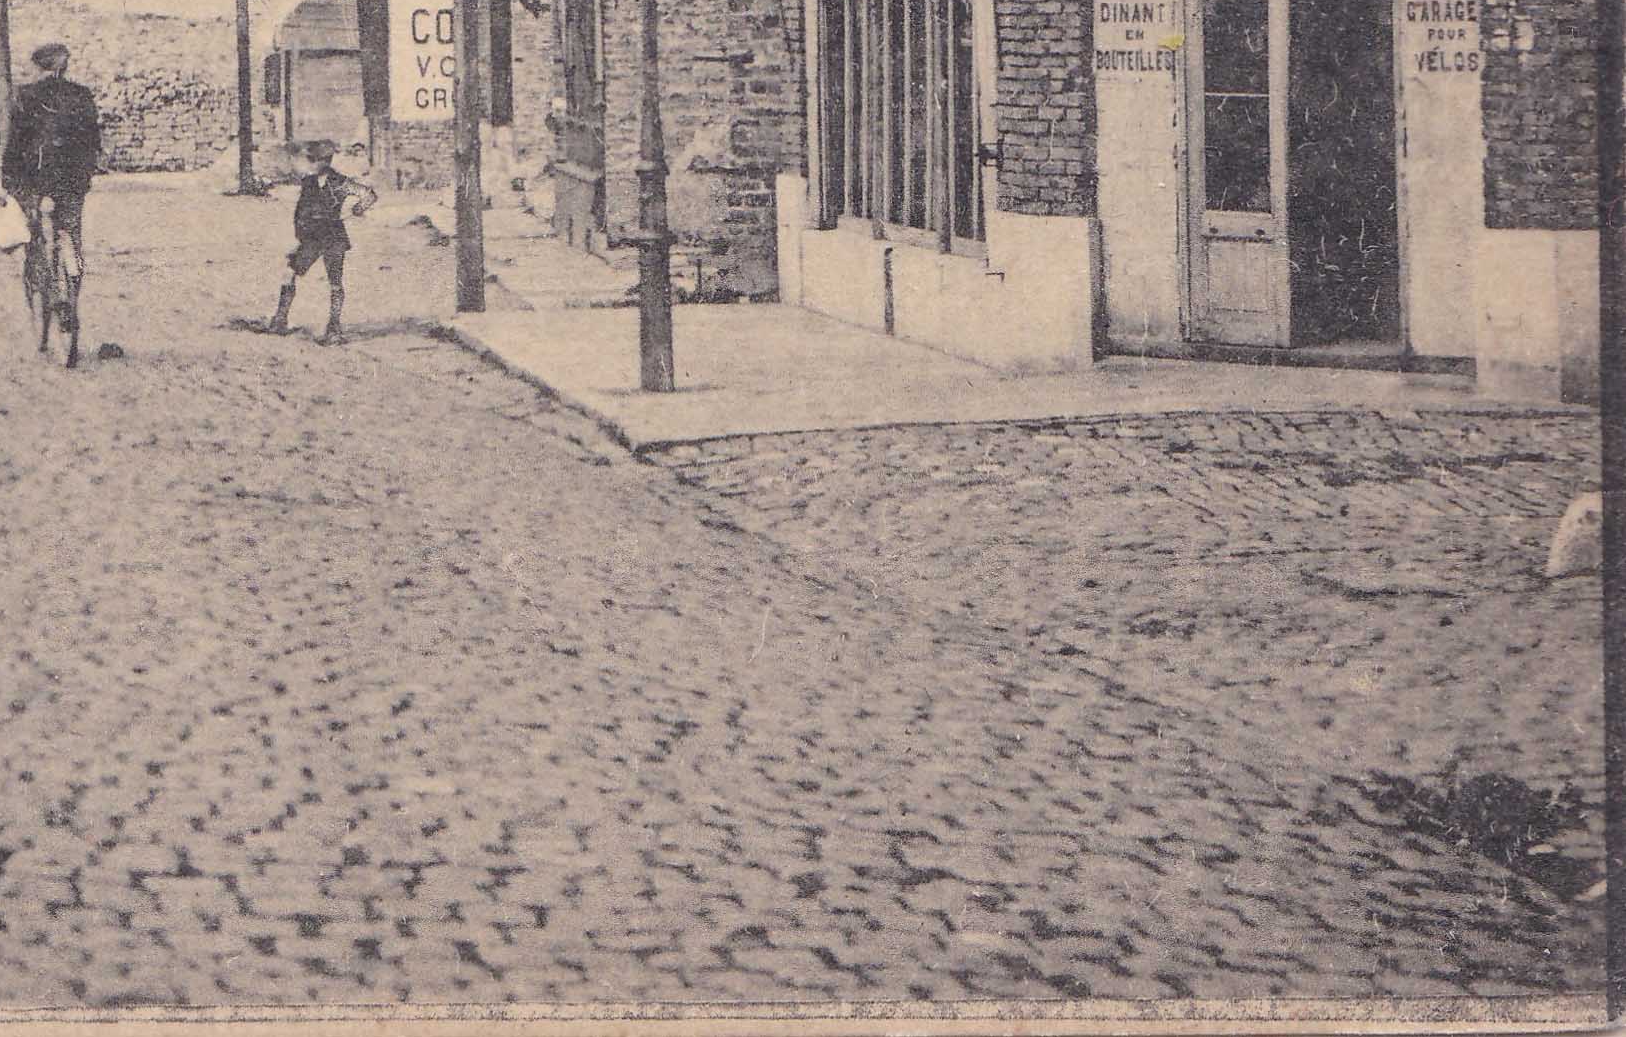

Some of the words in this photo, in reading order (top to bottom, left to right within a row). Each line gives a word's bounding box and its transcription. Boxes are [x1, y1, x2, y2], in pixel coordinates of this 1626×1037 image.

[1100, 2, 1166, 23] DINANT
[1406, 0, 1478, 23] GARAGE
[1125, 29, 1144, 41] EN
[1427, 28, 1467, 42] POUR
[1095, 49, 1173, 72] BOUTEILLES
[1414, 45, 1480, 73] VÉLOS
